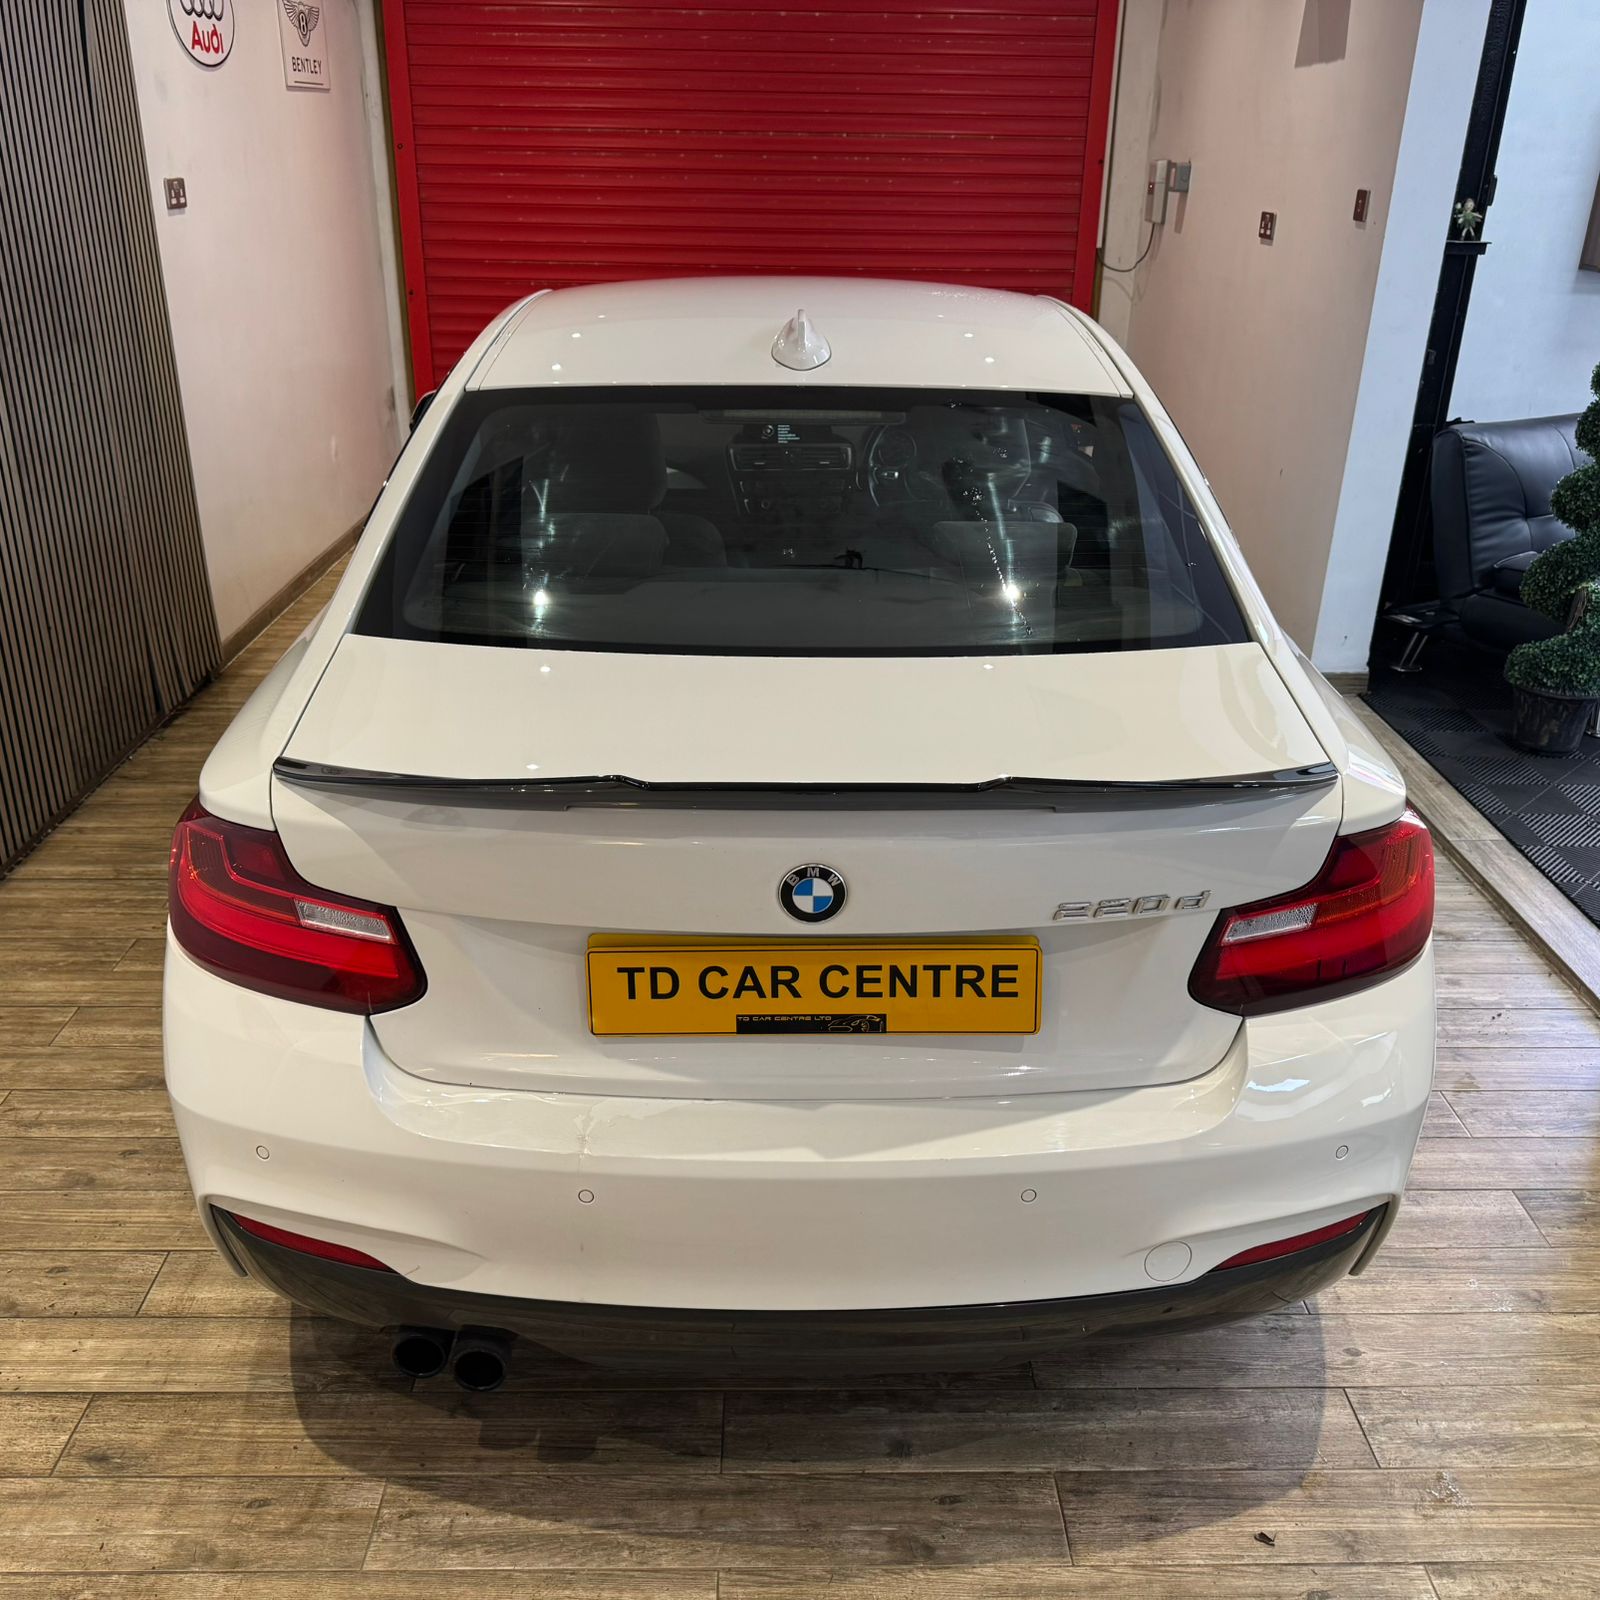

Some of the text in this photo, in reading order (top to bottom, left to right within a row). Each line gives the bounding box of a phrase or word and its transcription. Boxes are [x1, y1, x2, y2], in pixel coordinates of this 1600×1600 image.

[191, 20, 224, 54] Audi
[291, 56, 322, 75] BENTLEY
[786, 867, 841, 887] BMW
[616, 964, 1019, 1000] TD CAR CENTRE
